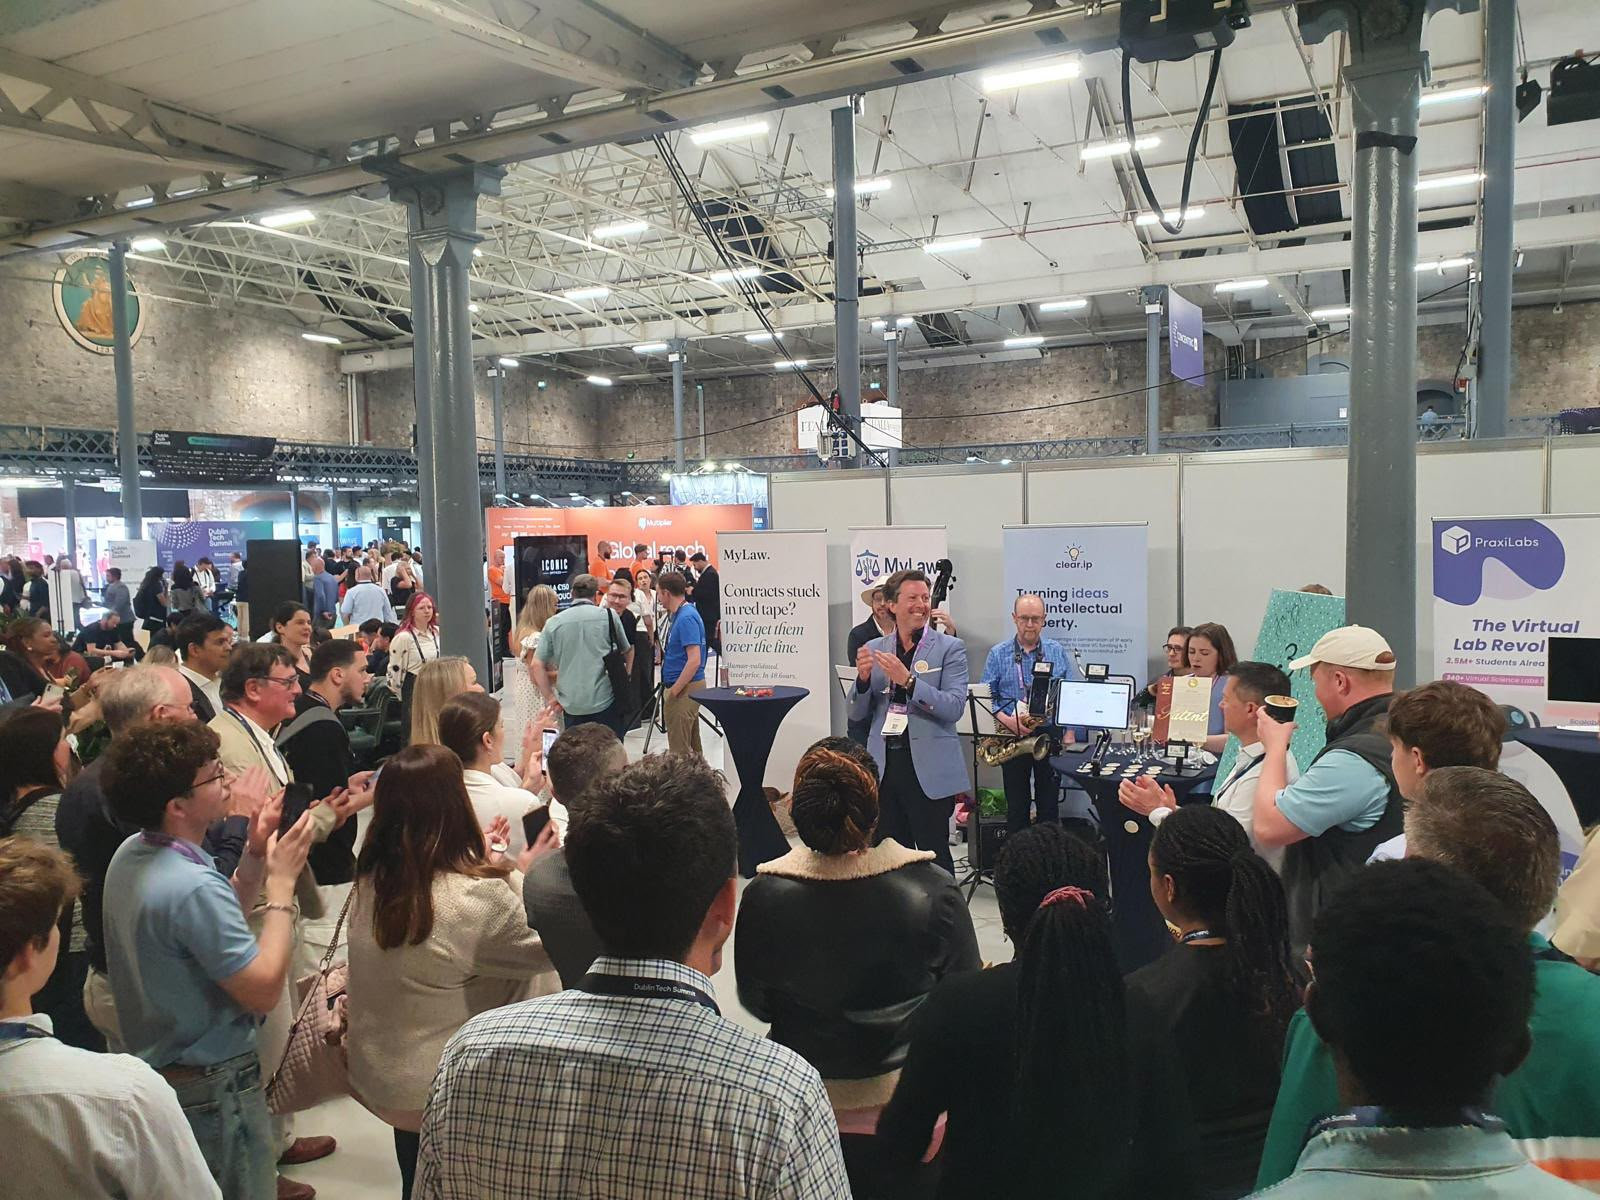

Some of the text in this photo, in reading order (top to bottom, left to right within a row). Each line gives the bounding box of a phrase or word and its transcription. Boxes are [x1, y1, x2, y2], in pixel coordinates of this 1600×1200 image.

[1475, 536, 1539, 548] PraxiLabs
[724, 549, 770, 563] MyLaw.
[541, 558, 568, 571] ICONIC
[724, 583, 821, 598] Contracts stuck
[1071, 587, 1109, 599] ideas
[725, 601, 797, 619] in red tape?
[1046, 603, 1123, 614] Intellectual
[725, 621, 805, 639] We'll get them
[1472, 619, 1580, 633] The Virtual
[725, 639, 799, 654] over the line.
[1453, 638, 1546, 653] Lab Revol
[1475, 658, 1517, 666] Students
[1519, 659, 1545, 667] Alrea
[634, 983, 696, 996] Dublin Tech Summit
